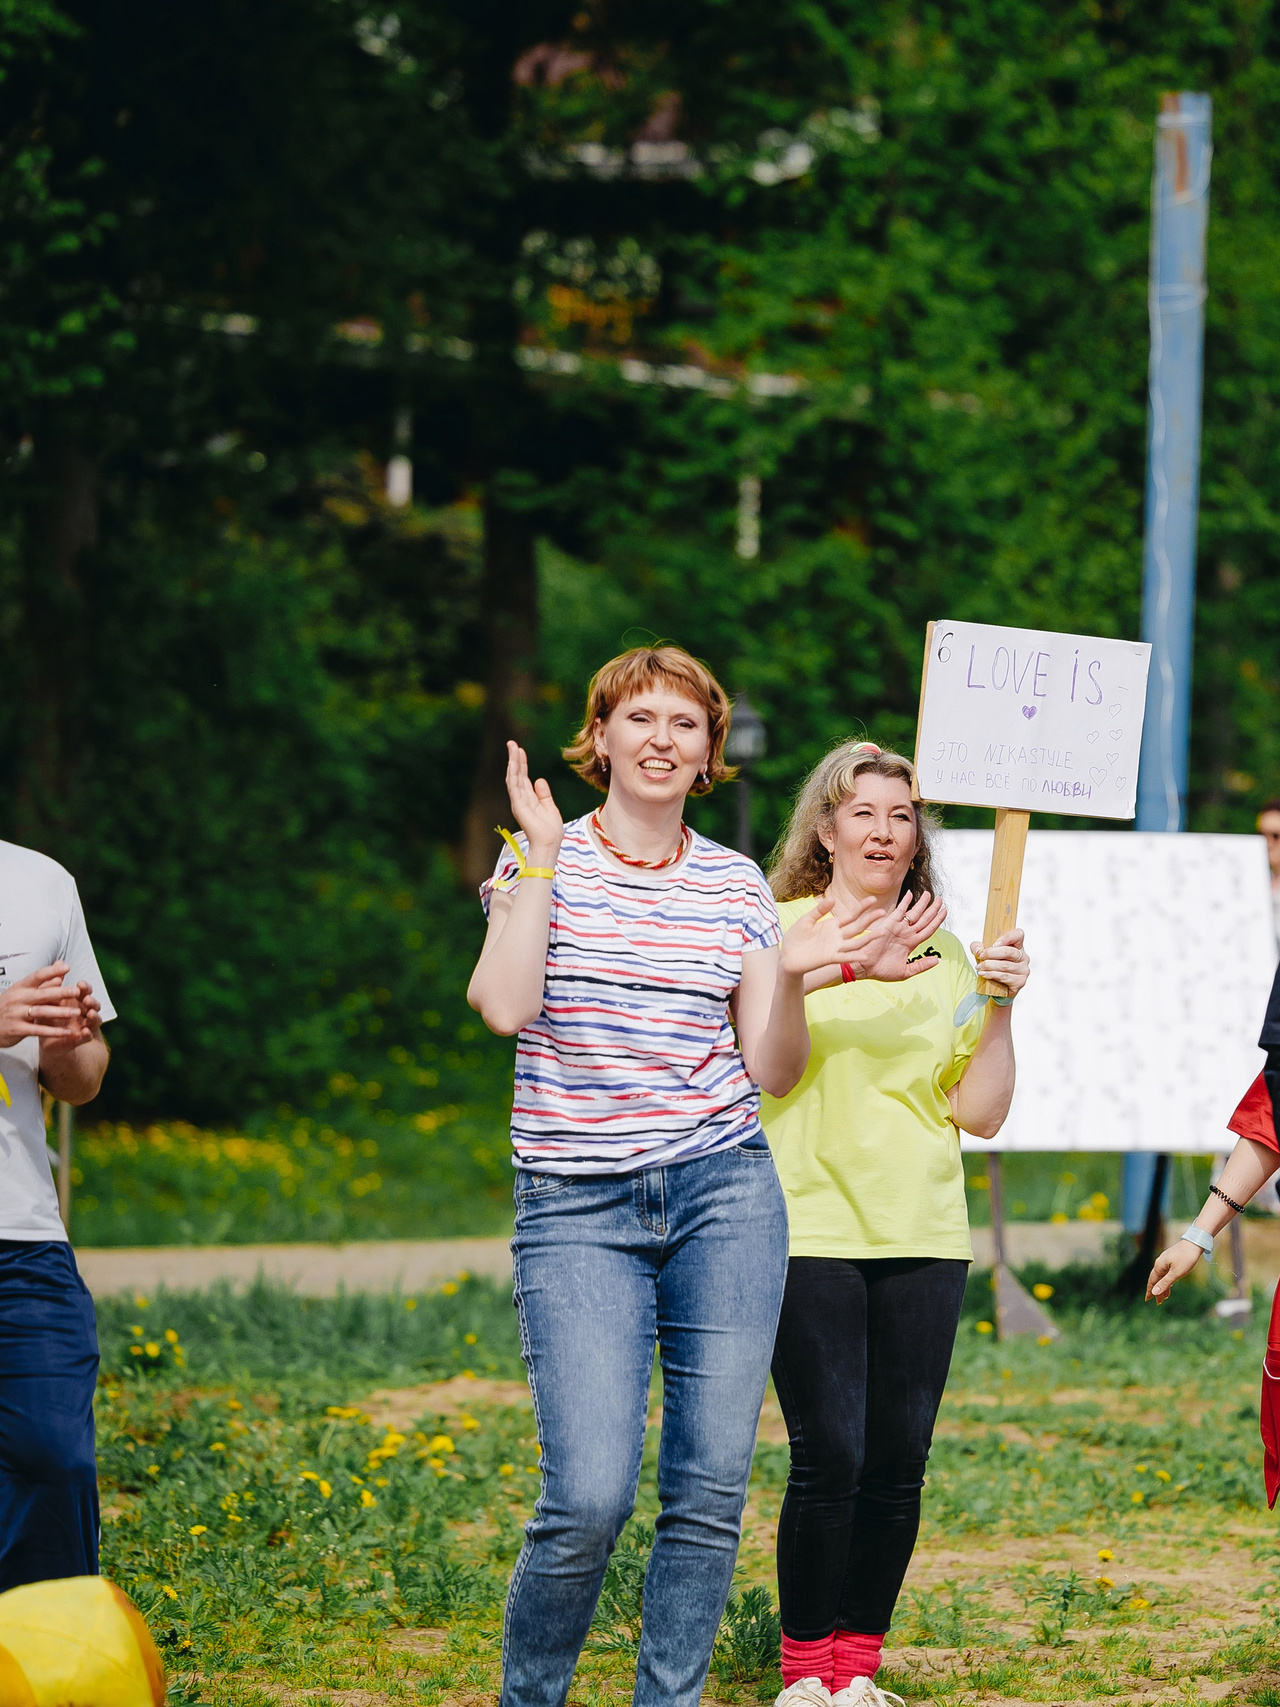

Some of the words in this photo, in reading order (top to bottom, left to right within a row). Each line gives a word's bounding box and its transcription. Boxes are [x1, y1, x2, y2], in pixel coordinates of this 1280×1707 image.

[937, 632, 954, 663] 6
[967, 644, 1051, 697] LOVE
[931, 741, 968, 763] ЭТО
[983, 743, 1074, 770] NIKASTYLE
[950, 771, 976, 786] НАС
[985, 772, 1011, 790] ВСЁ
[1021, 777, 1038, 793] ПО
[1041, 779, 1092, 799] ЛЮБВИ
